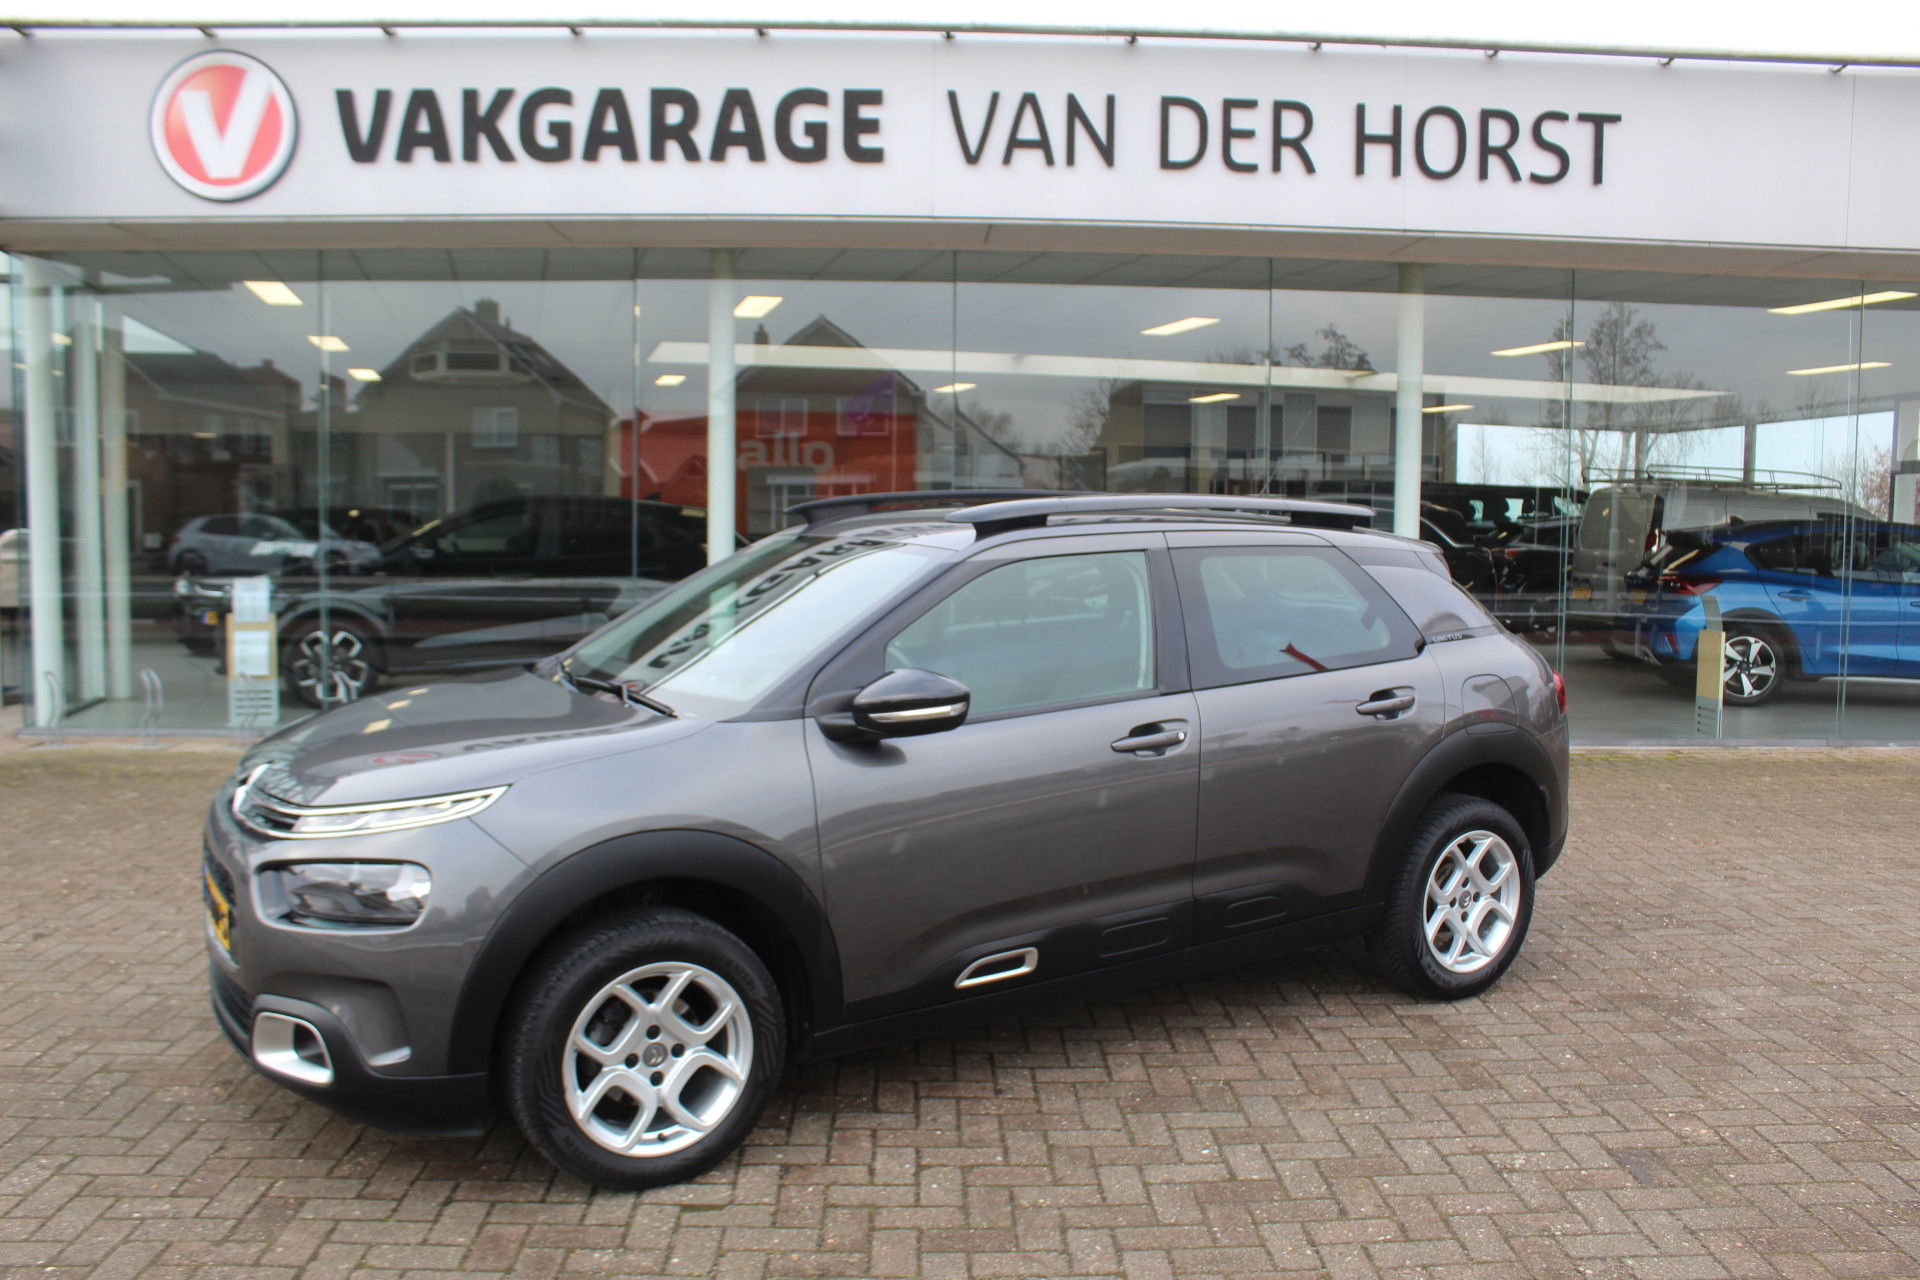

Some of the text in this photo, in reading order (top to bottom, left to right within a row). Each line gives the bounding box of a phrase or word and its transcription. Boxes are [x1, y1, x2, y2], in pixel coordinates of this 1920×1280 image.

[335, 88, 1622, 186] VAKGARAGE VAN DER HORST
